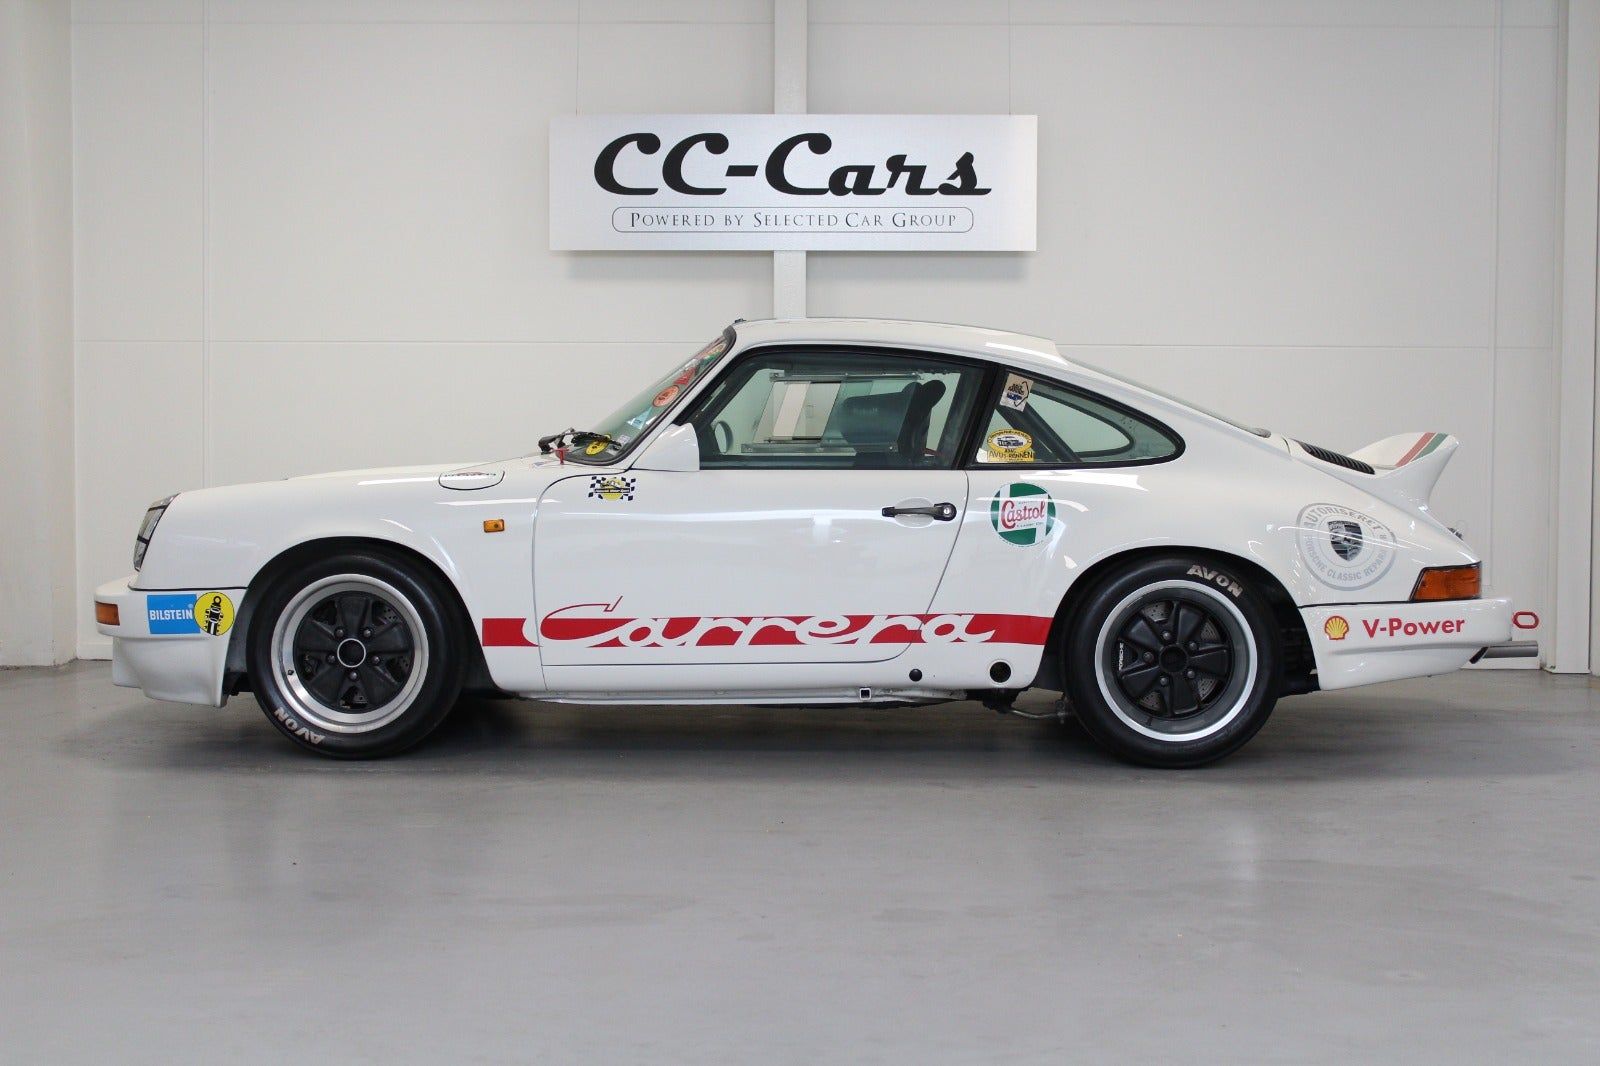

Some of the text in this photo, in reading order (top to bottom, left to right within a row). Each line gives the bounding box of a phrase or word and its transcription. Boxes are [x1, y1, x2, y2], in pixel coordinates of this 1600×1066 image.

[594, 132, 992, 197] CC-Cars
[630, 211, 957, 228] POWERED BY SELECTED CAR GROUP
[1001, 500, 1046, 529] Castrol
[1187, 564, 1243, 598] AVON
[1327, 568, 1362, 581] CLASSIC
[149, 609, 193, 621] BILSTEIN
[522, 597, 996, 649] Carrera
[1362, 617, 1465, 639] V-Power
[273, 706, 326, 745] AVON
